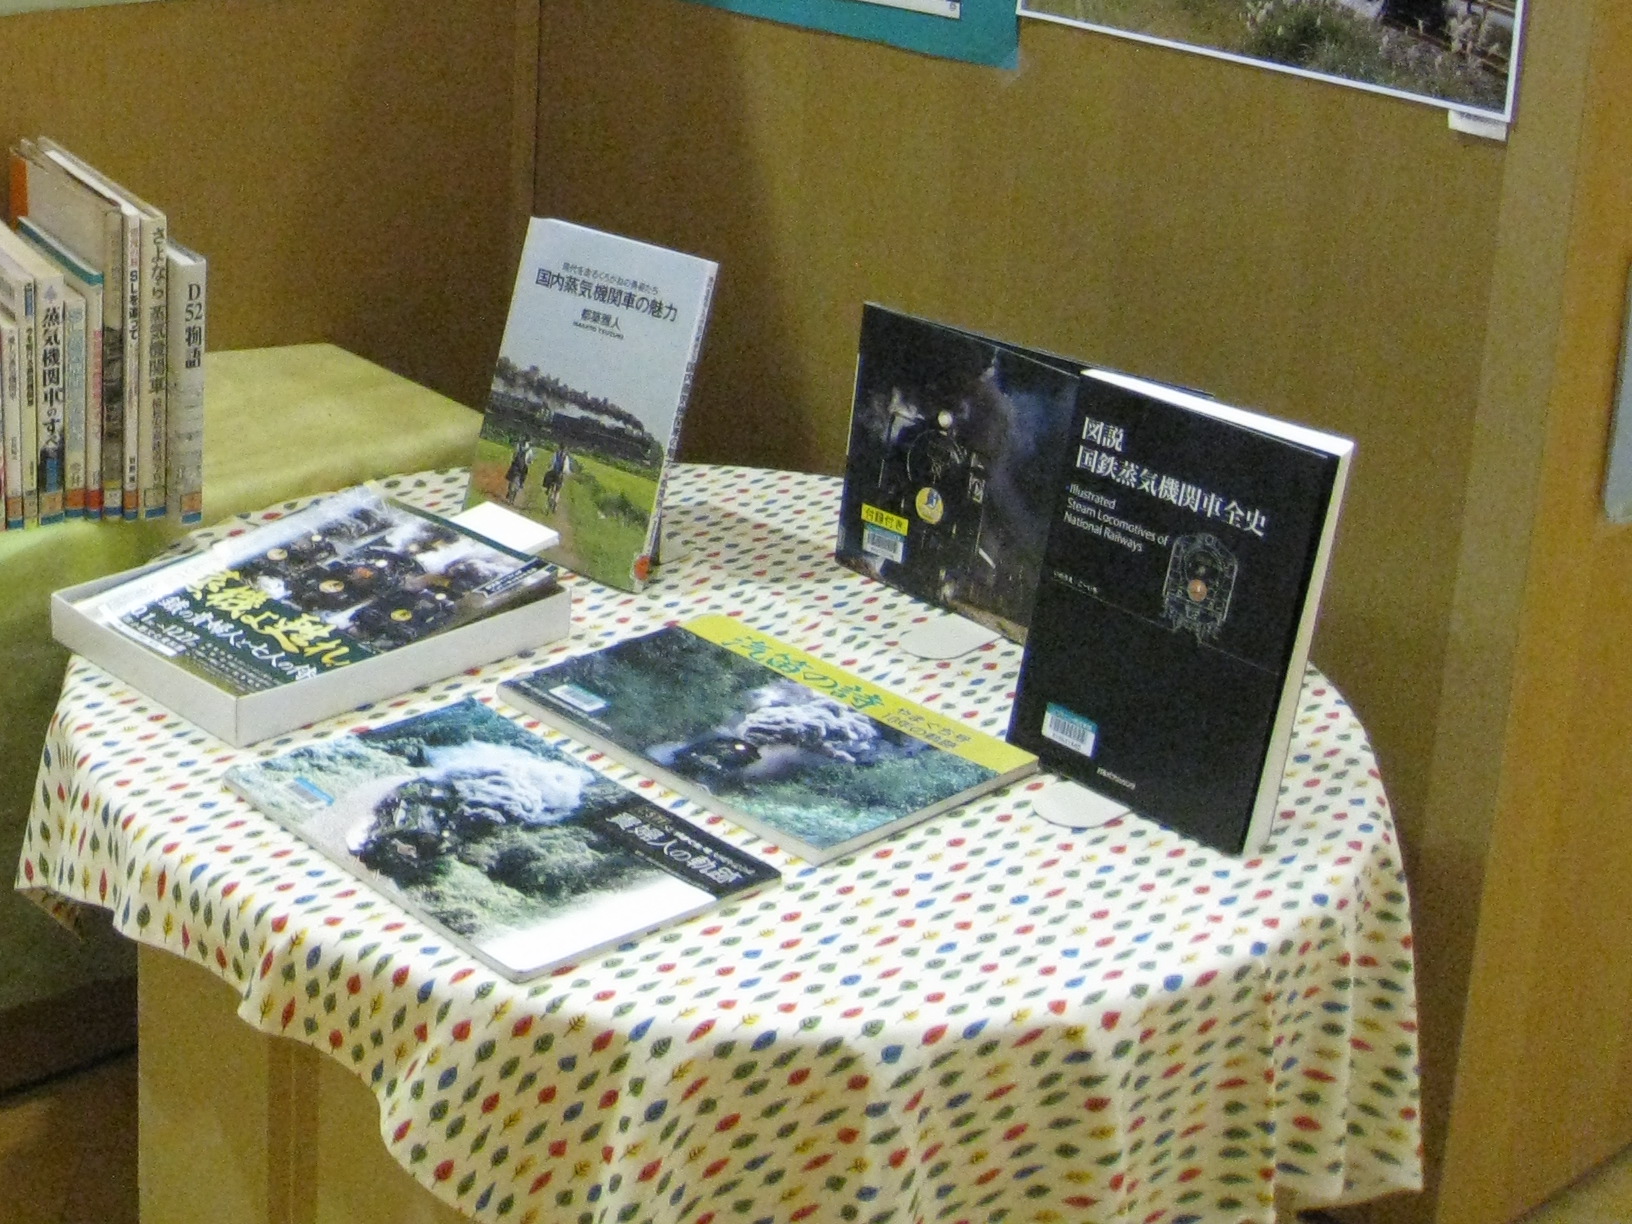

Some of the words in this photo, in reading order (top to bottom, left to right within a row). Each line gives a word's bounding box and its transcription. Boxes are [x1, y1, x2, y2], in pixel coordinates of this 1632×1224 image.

[535, 268, 678, 323] 国内蒸気機関車の魅力
[185, 283, 202, 370] D52物語
[1081, 416, 1125, 452] 図説
[1069, 484, 1116, 509] Illustrated
[1075, 445, 1267, 537] 国鉄蒸気機関車全史
[1064, 511, 1103, 536] National
[1103, 525, 1143, 553] Railways
[1068, 497, 1096, 518] Steam
[1097, 508, 1156, 541] Locomotives
[1157, 535, 1169, 547] of
[721, 636, 886, 709] 汽笛の詩
